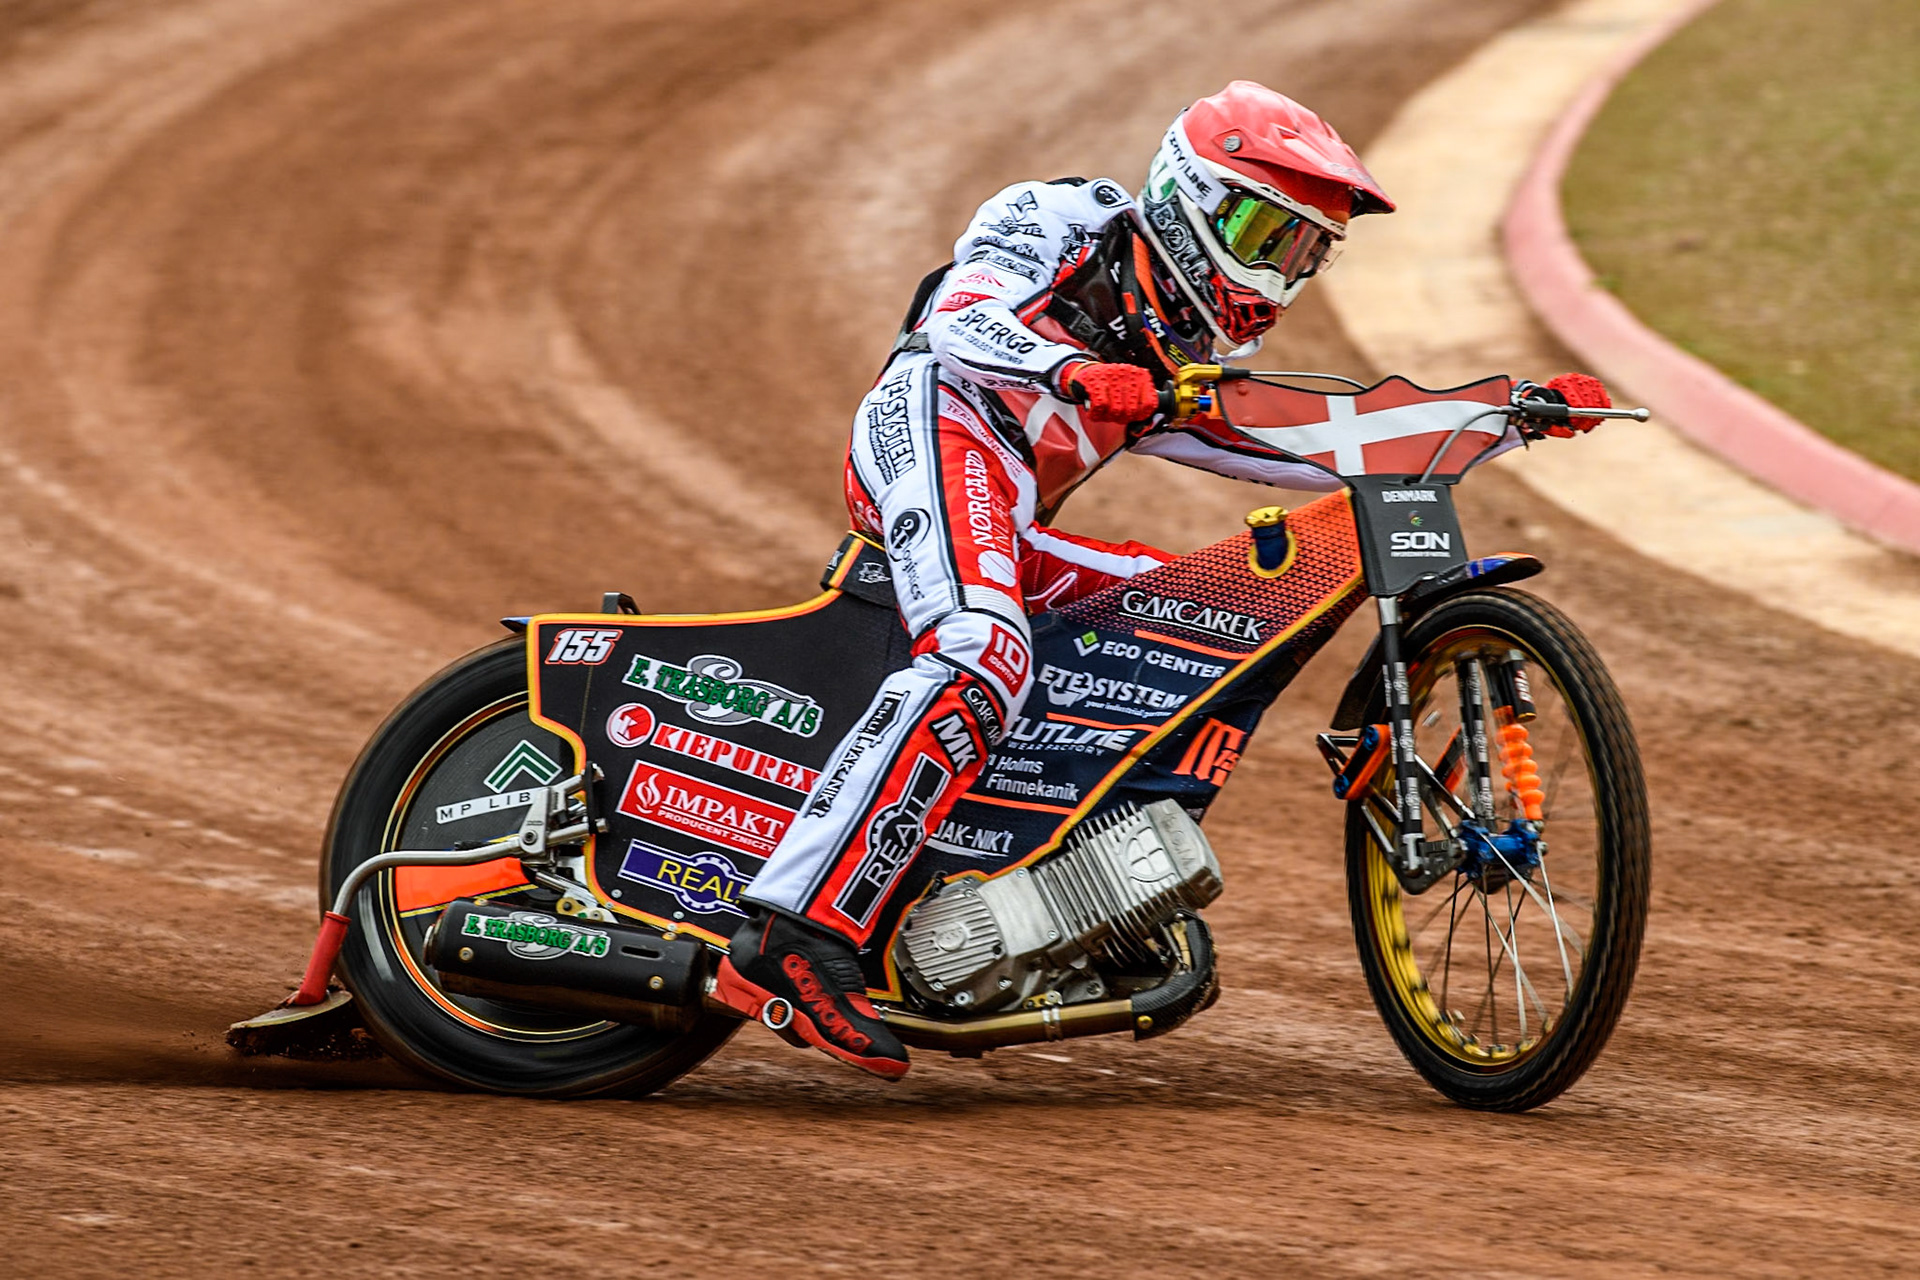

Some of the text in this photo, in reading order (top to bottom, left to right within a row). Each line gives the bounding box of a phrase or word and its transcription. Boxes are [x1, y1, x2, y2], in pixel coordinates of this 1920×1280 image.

[965, 449, 996, 549] NØRGAARD
[1381, 490, 1438, 503] DENMARK
[1390, 531, 1451, 550] SON
[1121, 590, 1267, 641] GARCAREK
[549, 630, 620, 662] 155
[1100, 640, 1227, 679] ECO CENTER
[653, 663, 770, 719] TRASBORG
[771, 698, 820, 735] A/S
[1091, 677, 1189, 710] SYSTEM
[932, 713, 979, 775] MK
[1005, 716, 1137, 752] UTLINE
[1044, 743, 1105, 757] FACTORY
[653, 725, 822, 794] KIEPUREX
[995, 756, 1044, 774] Holms
[986, 773, 1080, 801] Finmekanik
[657, 809, 732, 838] PRODUCENT
[663, 785, 785, 840] IMPAKT
[484, 919, 571, 950] TRASBORG
[575, 934, 608, 956] A/S
[782, 954, 873, 1054] daytona
